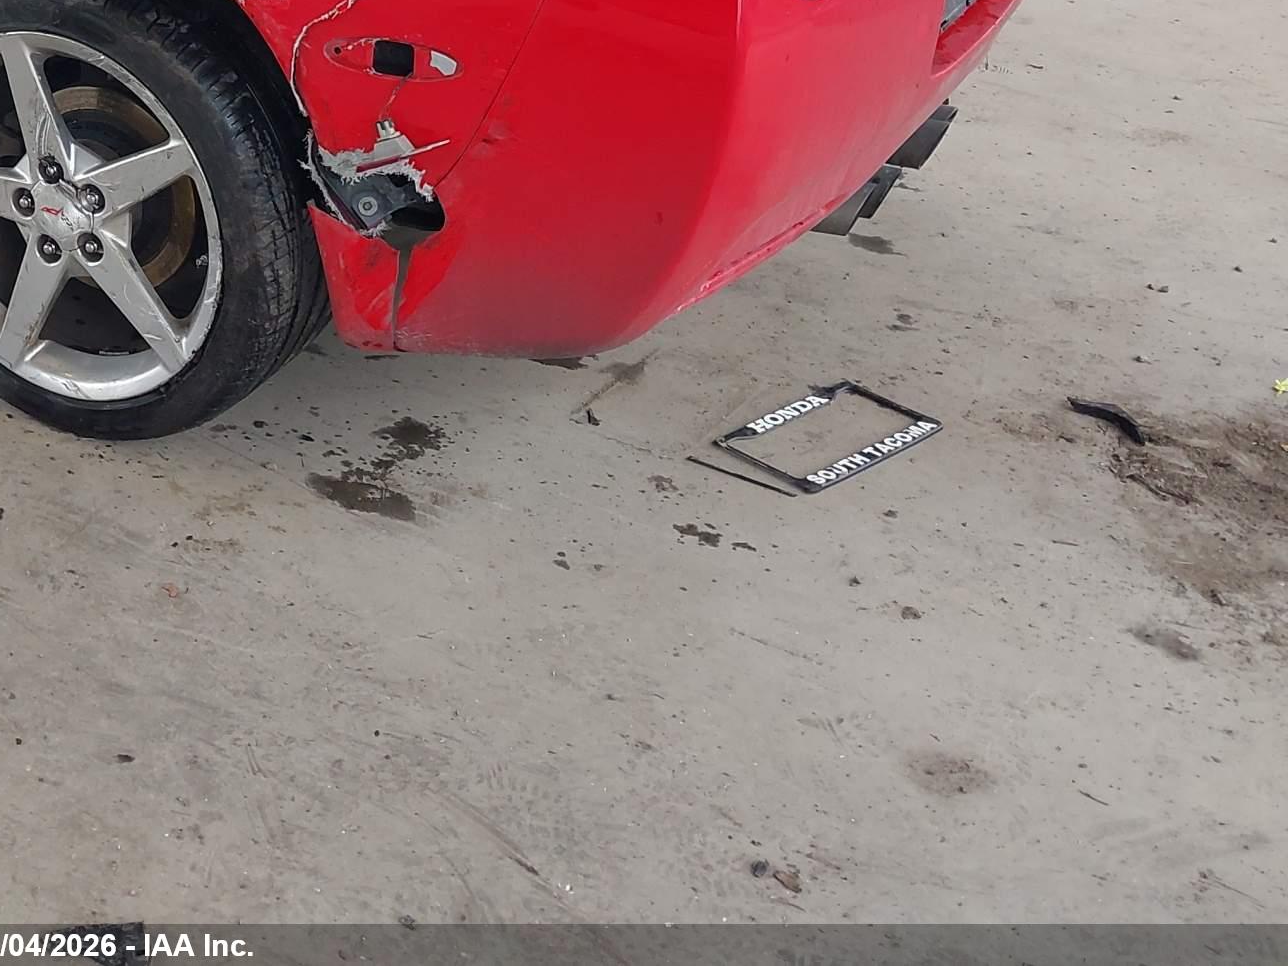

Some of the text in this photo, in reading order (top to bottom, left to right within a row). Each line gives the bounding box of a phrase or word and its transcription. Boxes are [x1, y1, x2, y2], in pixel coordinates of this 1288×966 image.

[745, 395, 830, 434] HONDA
[806, 421, 938, 486] SOUTH TACOMA
